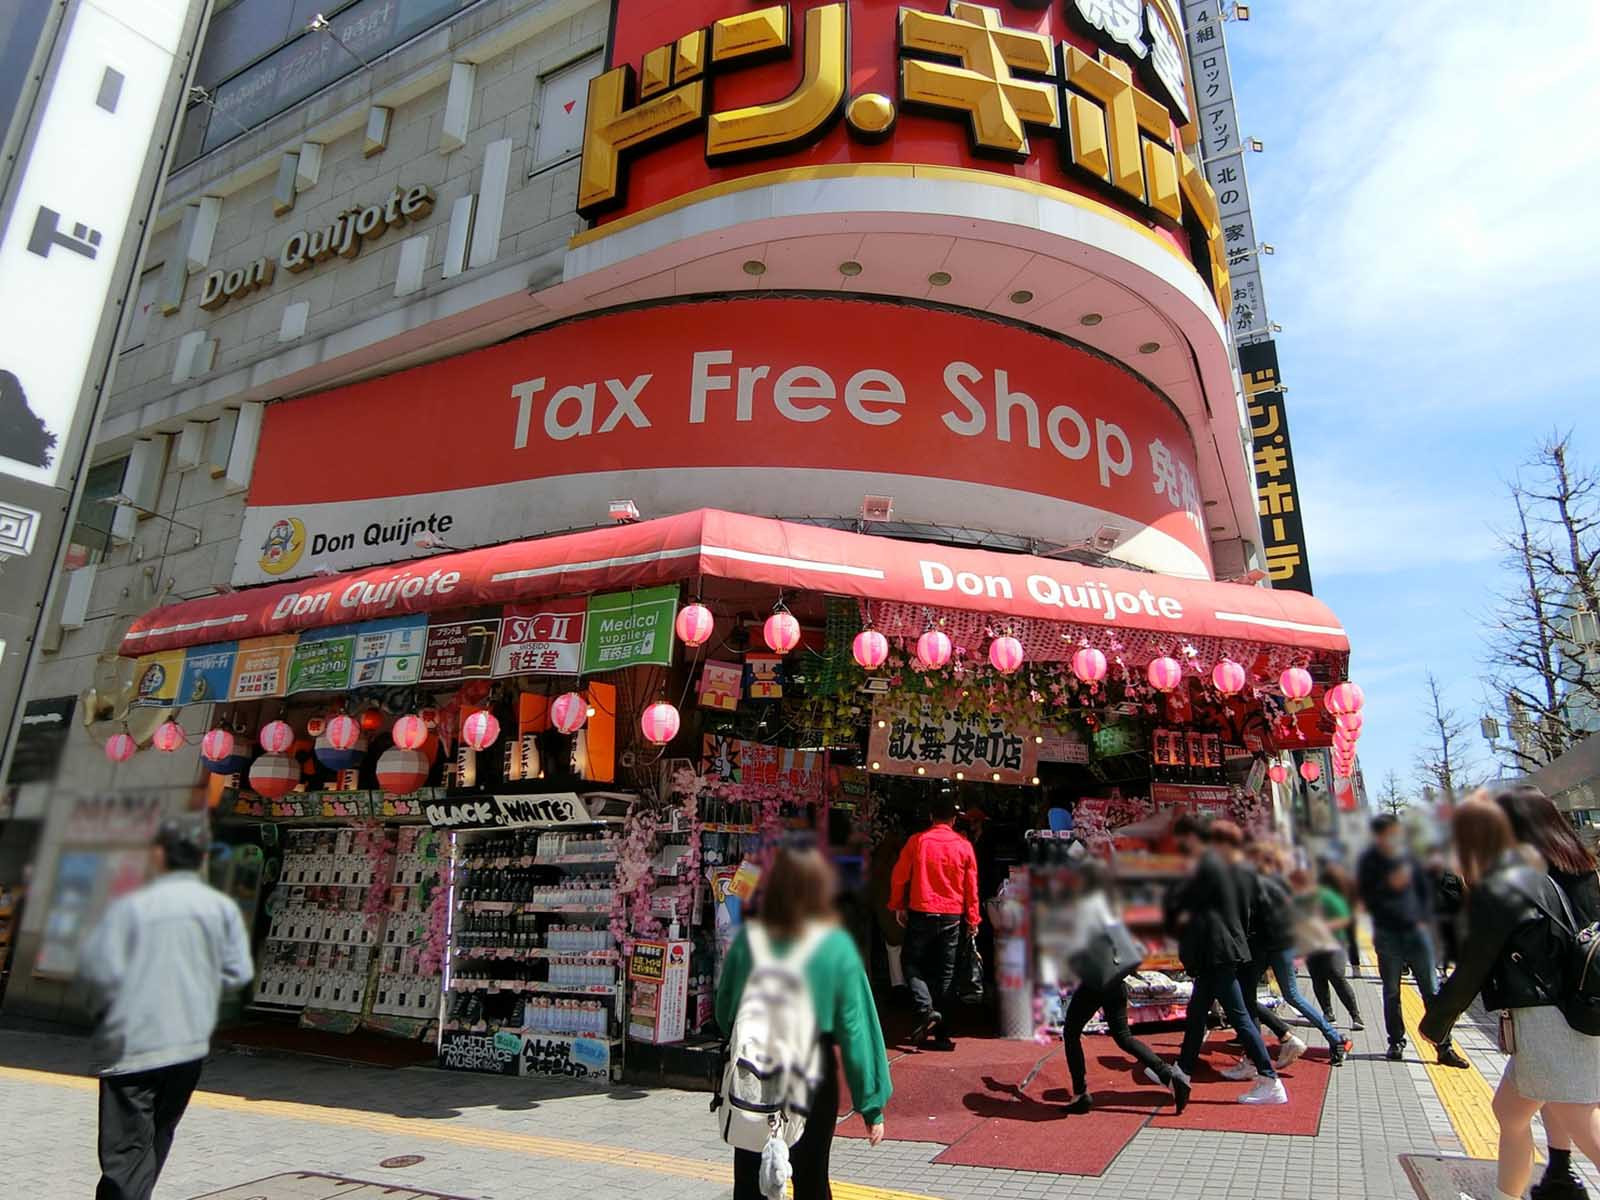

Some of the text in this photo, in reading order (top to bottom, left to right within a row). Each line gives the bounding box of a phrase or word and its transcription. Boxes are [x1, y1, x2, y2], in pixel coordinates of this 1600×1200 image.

[1217, 166, 1249, 266] 北の家族
[200, 183, 437, 311] Don Quijote
[511, 350, 1134, 488] Tax Free Shop
[311, 513, 453, 556] Don Quijote
[271, 569, 461, 620] Don Quijote
[919, 560, 1184, 620] Don Quijote
[509, 617, 571, 642] SK-II
[600, 610, 659, 633] Medical
[509, 650, 560, 671] 資生堂
[888, 717, 1023, 771] 歌舞伎町店
[426, 802, 495, 825] BLACK
[503, 799, 576, 823] WHITE?
[441, 1043, 512, 1062] FRAGRANCE
[451, 1034, 494, 1048] WHITE
[445, 1055, 482, 1068] MUSK
